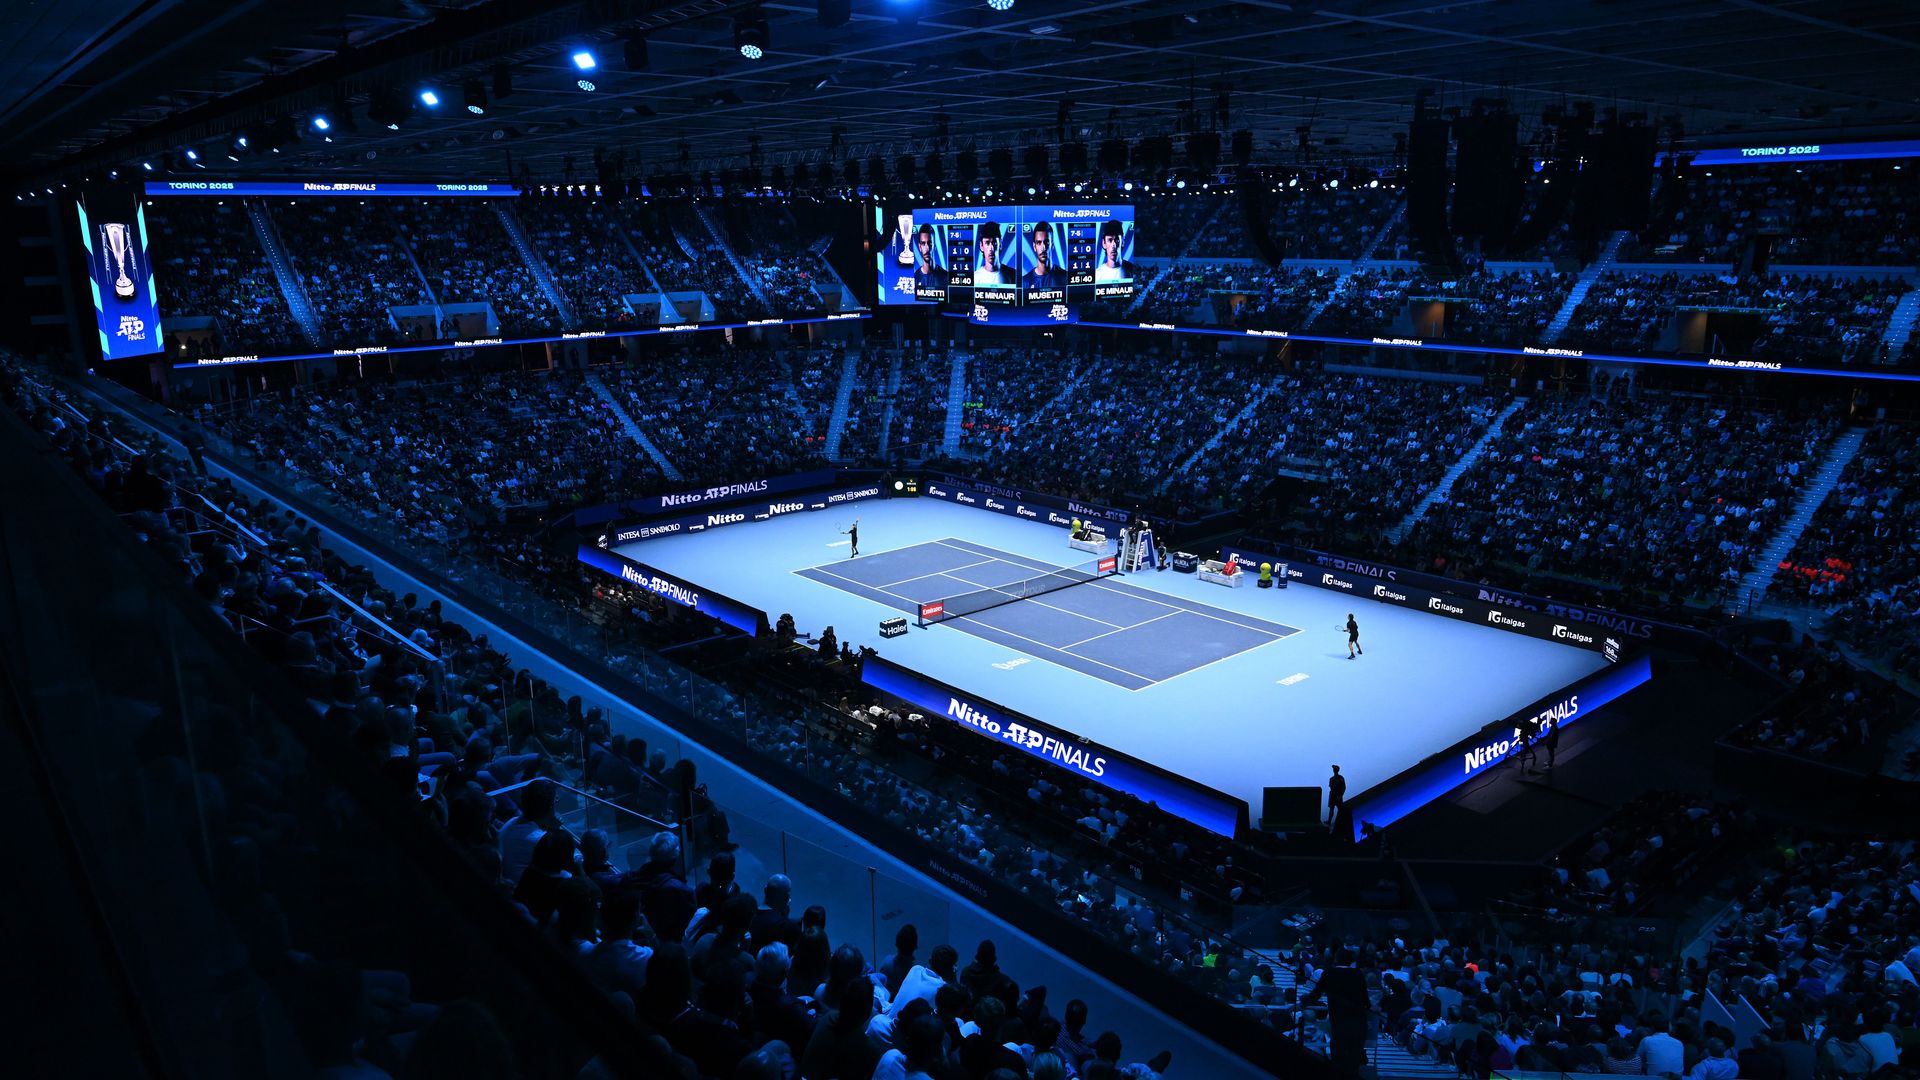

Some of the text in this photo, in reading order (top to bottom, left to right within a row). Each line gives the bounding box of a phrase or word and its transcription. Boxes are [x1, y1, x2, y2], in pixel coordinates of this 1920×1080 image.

[1742, 146, 1819, 156] TORINO 2025
[935, 212, 953, 220] Nitto
[968, 211, 987, 219] FINALS
[985, 292, 1015, 300] MINAUR
[1028, 291, 1062, 299] MUSETTI
[116, 320, 144, 337] ATP
[128, 333, 145, 341] FINALS
[1709, 358, 1735, 367] Nitto
[1754, 362, 1781, 370] FINALS
[662, 480, 767, 507] Nitto ATP FINALS
[828, 494, 846, 503] INTESA
[769, 502, 803, 515] Nitto
[1068, 502, 1101, 517] Nitto
[708, 513, 744, 526] Nitto
[618, 531, 640, 540] INTESA
[1238, 558, 1256, 567] italgas
[1346, 561, 1396, 581] FINALS
[622, 565, 698, 606] Nitto ATP FINALS
[1333, 579, 1353, 589] italgas
[1385, 590, 1406, 601] italgas
[922, 606, 943, 616] Emirates
[1441, 604, 1463, 614] italgas
[1502, 617, 1525, 628] italgas
[1586, 613, 1653, 639] FINALS
[888, 624, 906, 635] Haier
[1566, 632, 1593, 644] italgas
[948, 698, 1106, 777] Nitto ATP FINALS
[1464, 696, 1578, 774] Nitto FINALS
